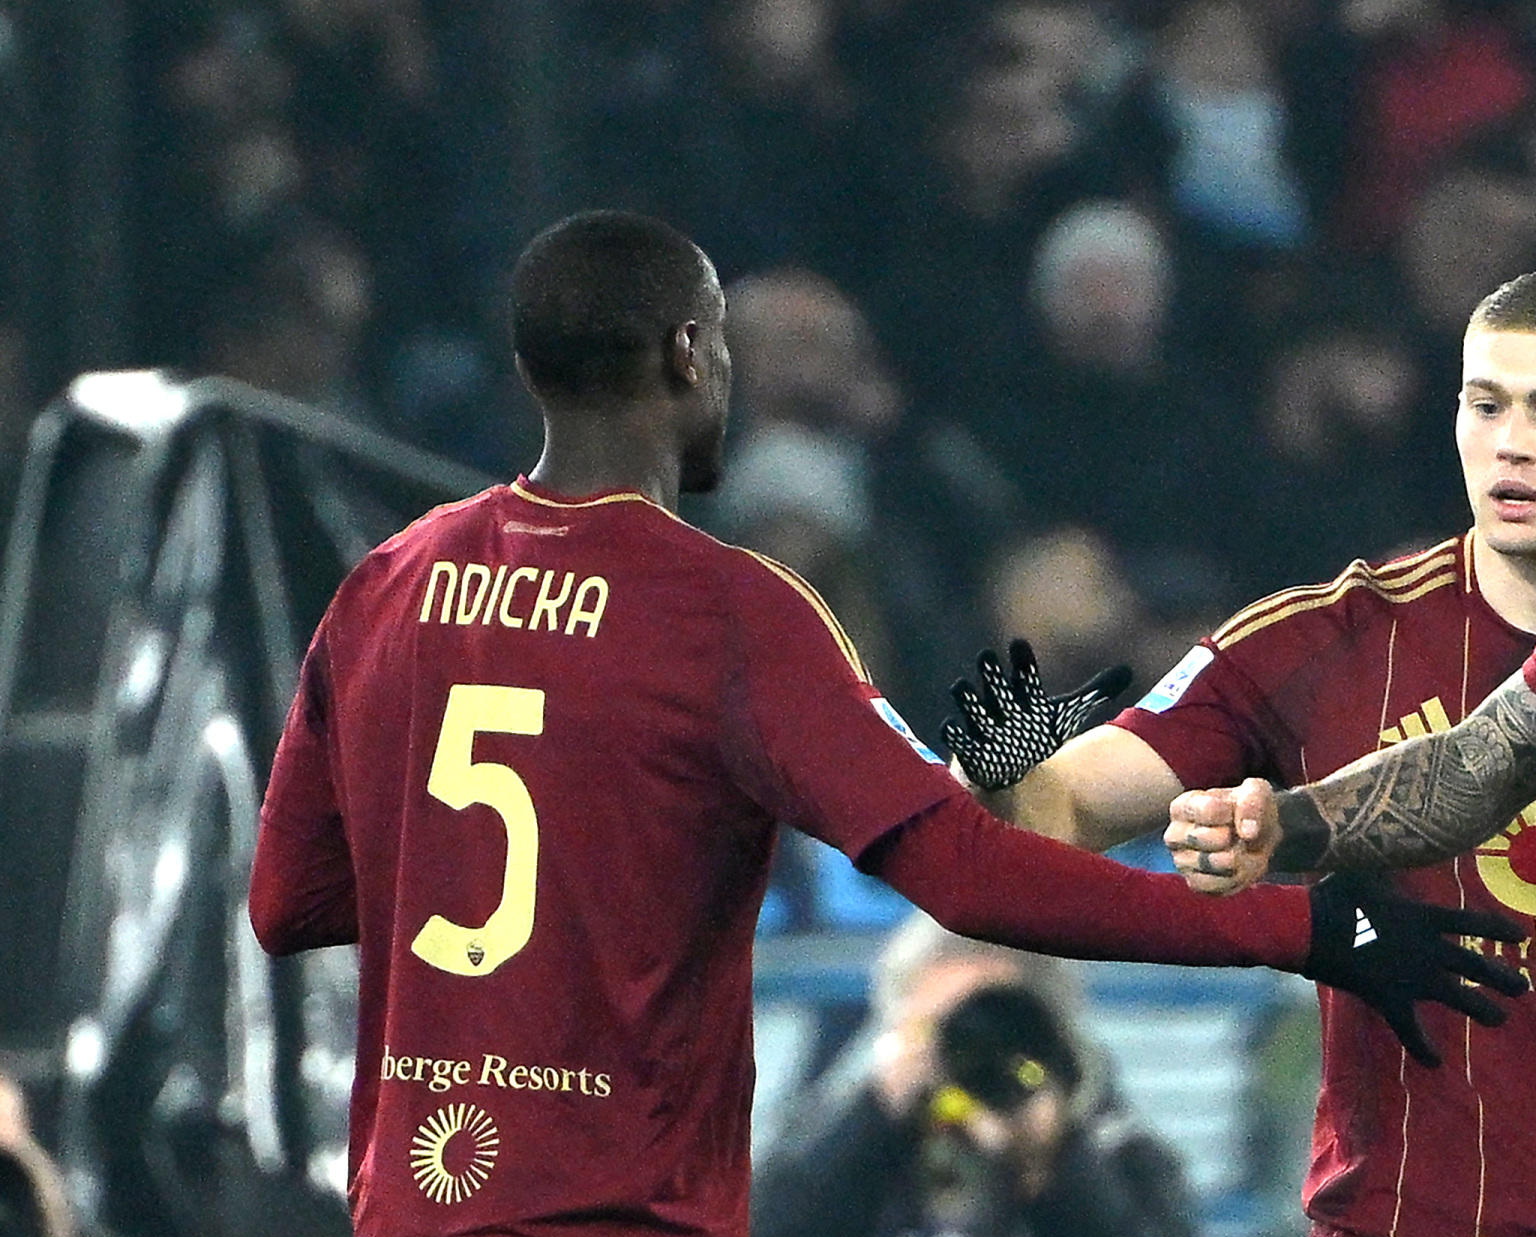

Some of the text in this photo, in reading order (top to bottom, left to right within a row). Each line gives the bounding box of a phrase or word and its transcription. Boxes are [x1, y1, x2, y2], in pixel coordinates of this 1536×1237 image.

[419, 560, 610, 639] NDICKA
[411, 683, 546, 977] 5
[477, 1053, 611, 1098] Resorts
